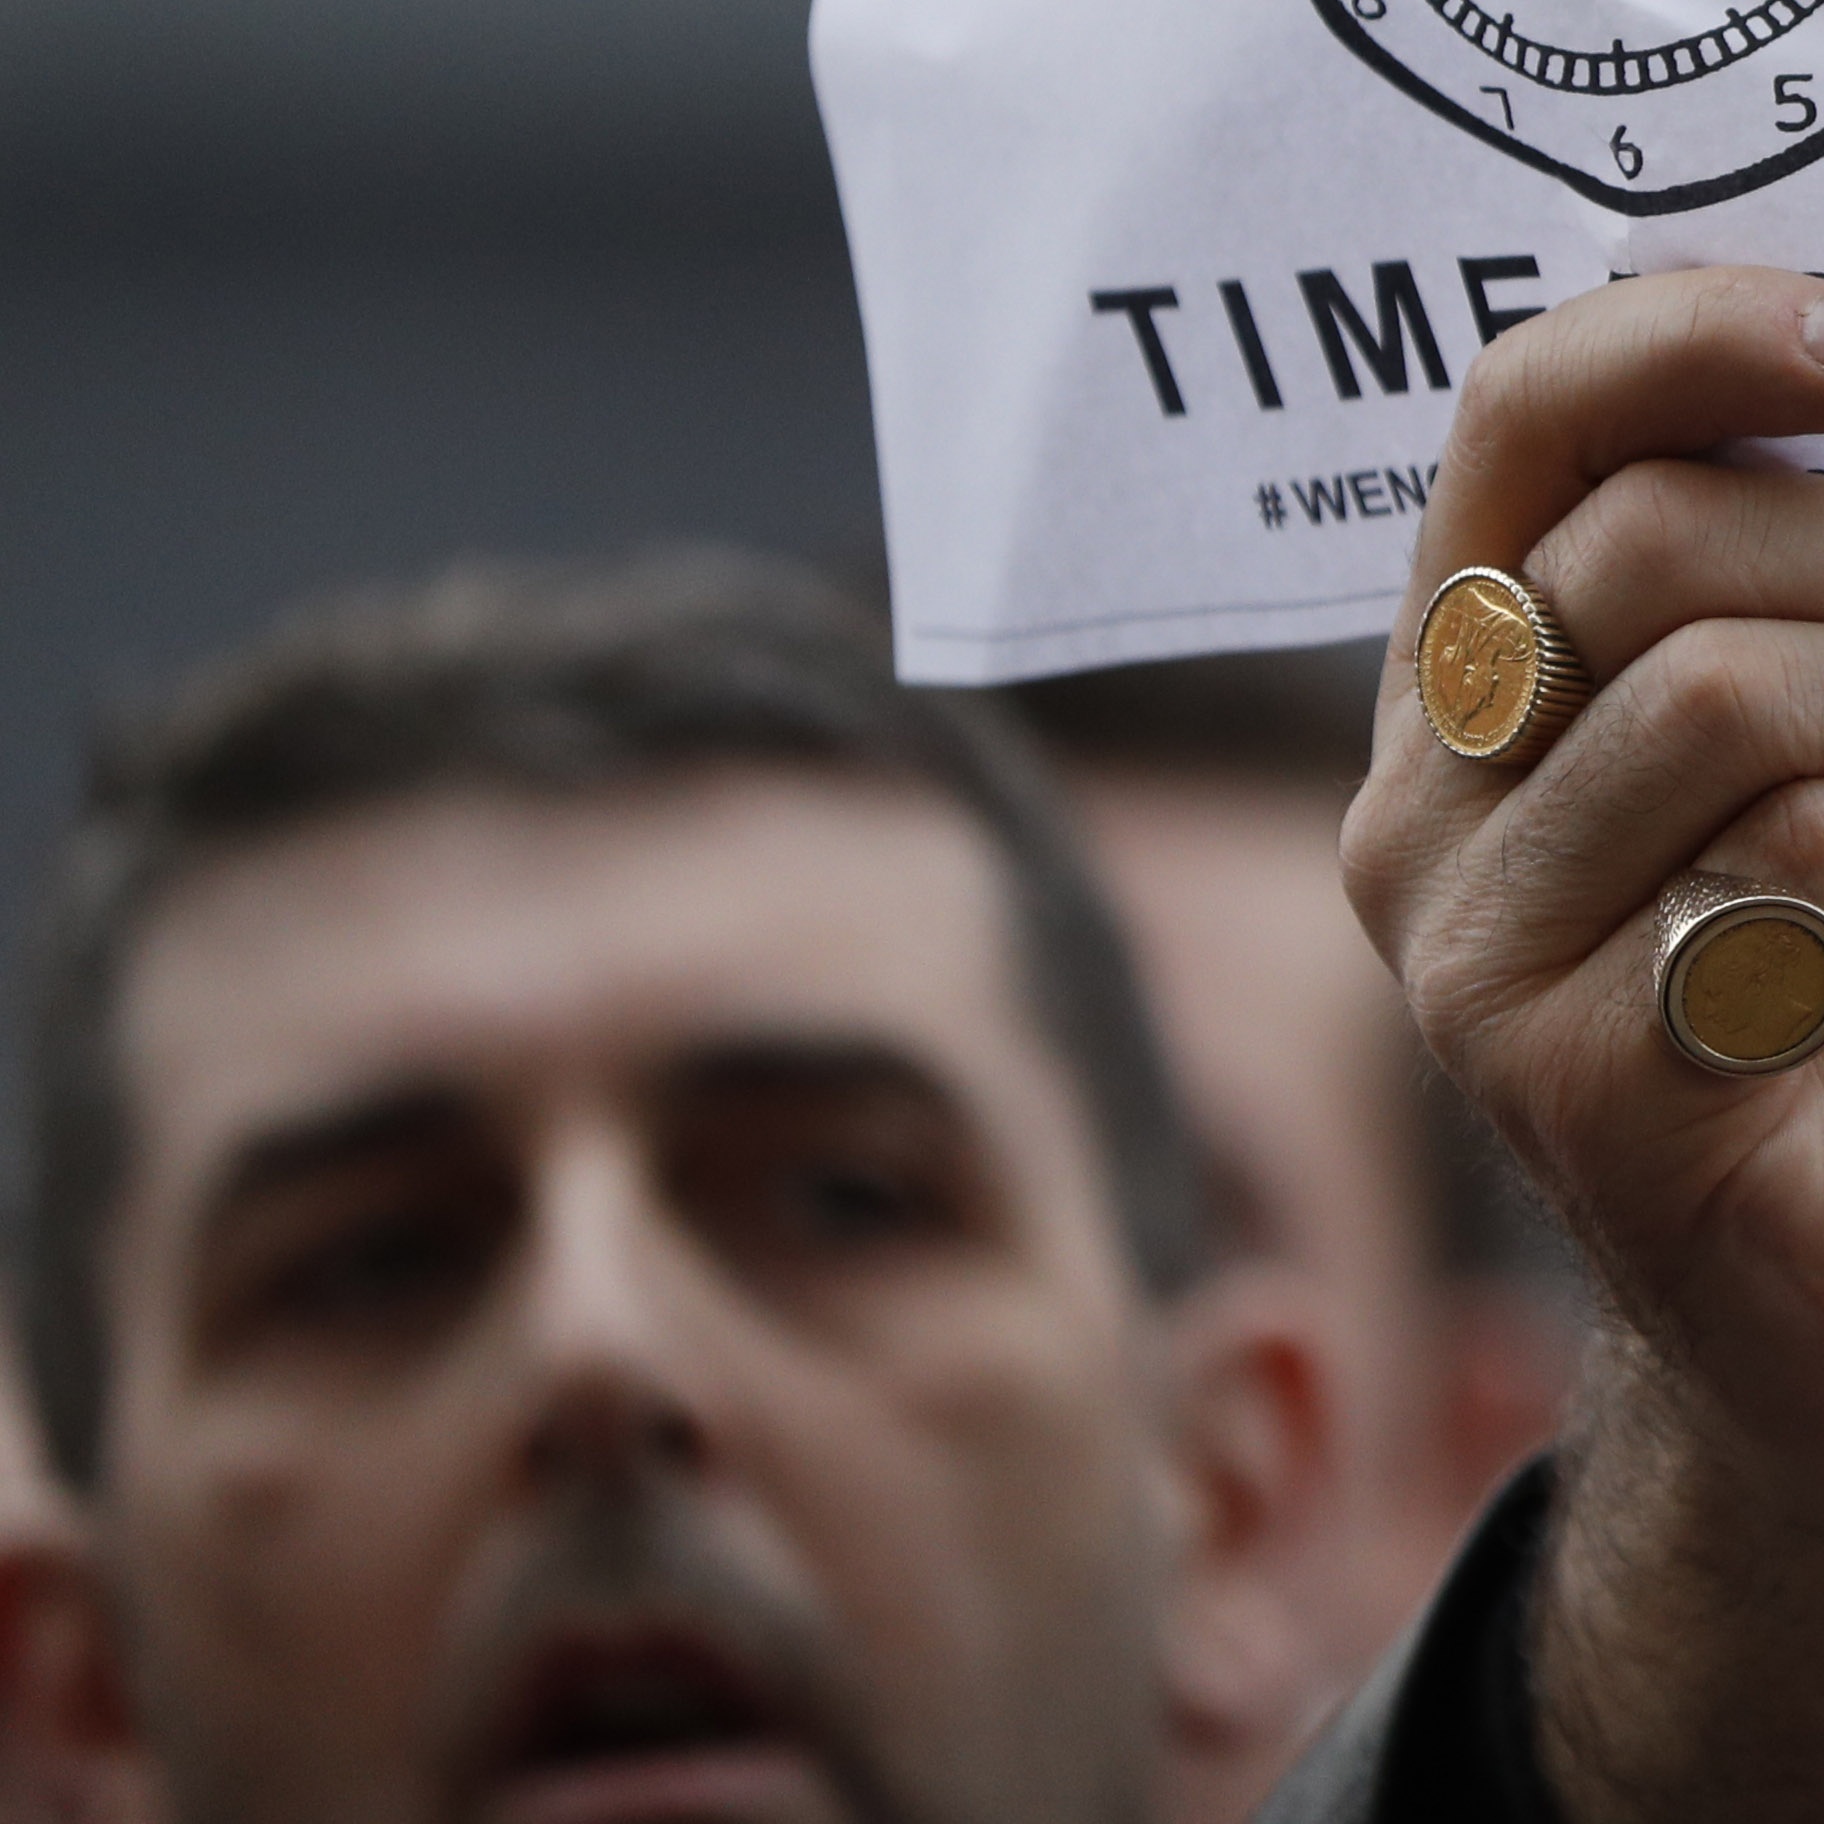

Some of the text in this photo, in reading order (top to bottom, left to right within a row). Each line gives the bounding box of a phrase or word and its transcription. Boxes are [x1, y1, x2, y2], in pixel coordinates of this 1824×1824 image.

[1477, 84, 1517, 133] 7
[1771, 71, 1820, 135] 5
[1607, 122, 1646, 183] 6
